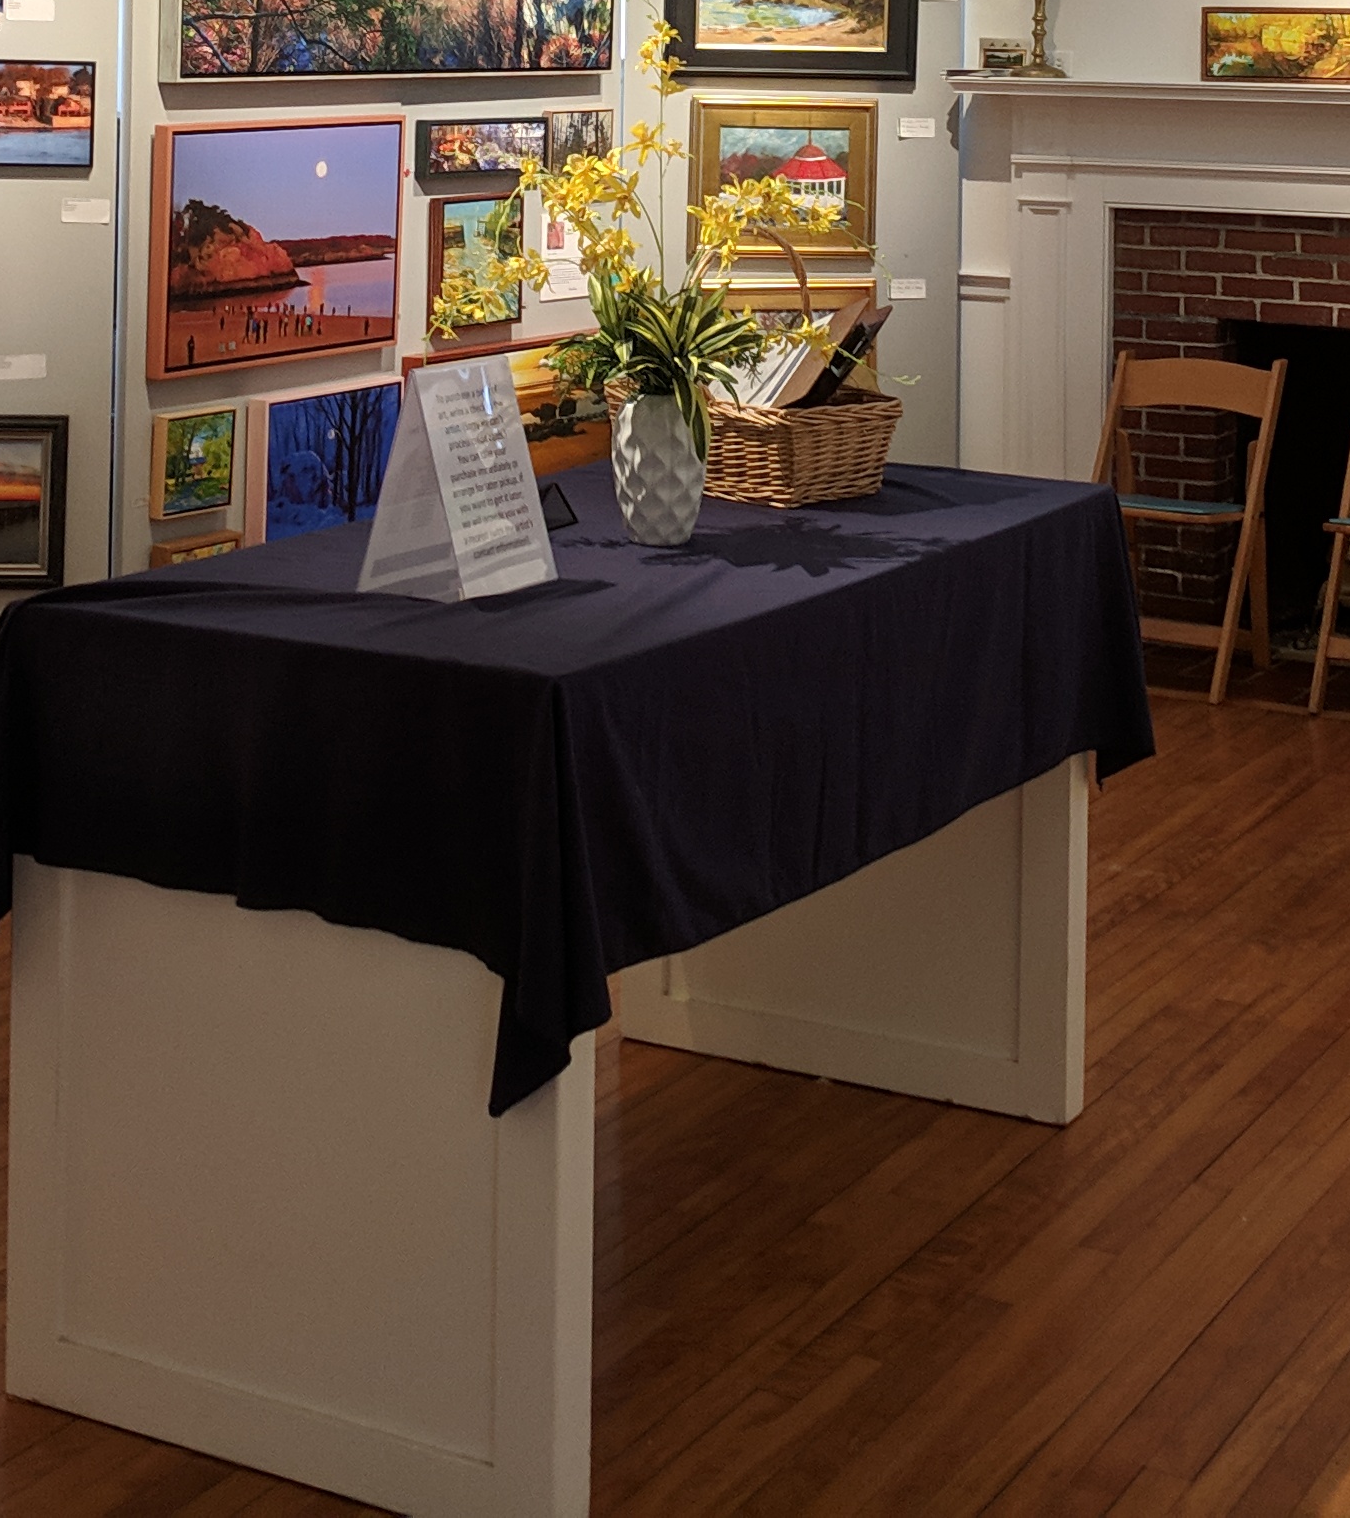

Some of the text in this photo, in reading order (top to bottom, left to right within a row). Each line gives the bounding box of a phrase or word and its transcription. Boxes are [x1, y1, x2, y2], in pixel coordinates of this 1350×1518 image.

[450, 470, 477, 483] purchase
[453, 487, 475, 498] arrange
[475, 483, 484, 492] for
[459, 505, 471, 513] you
[471, 499, 486, 510] want
[494, 495, 504, 507] get
[505, 510, 516, 519] you
[516, 504, 529, 515] with
